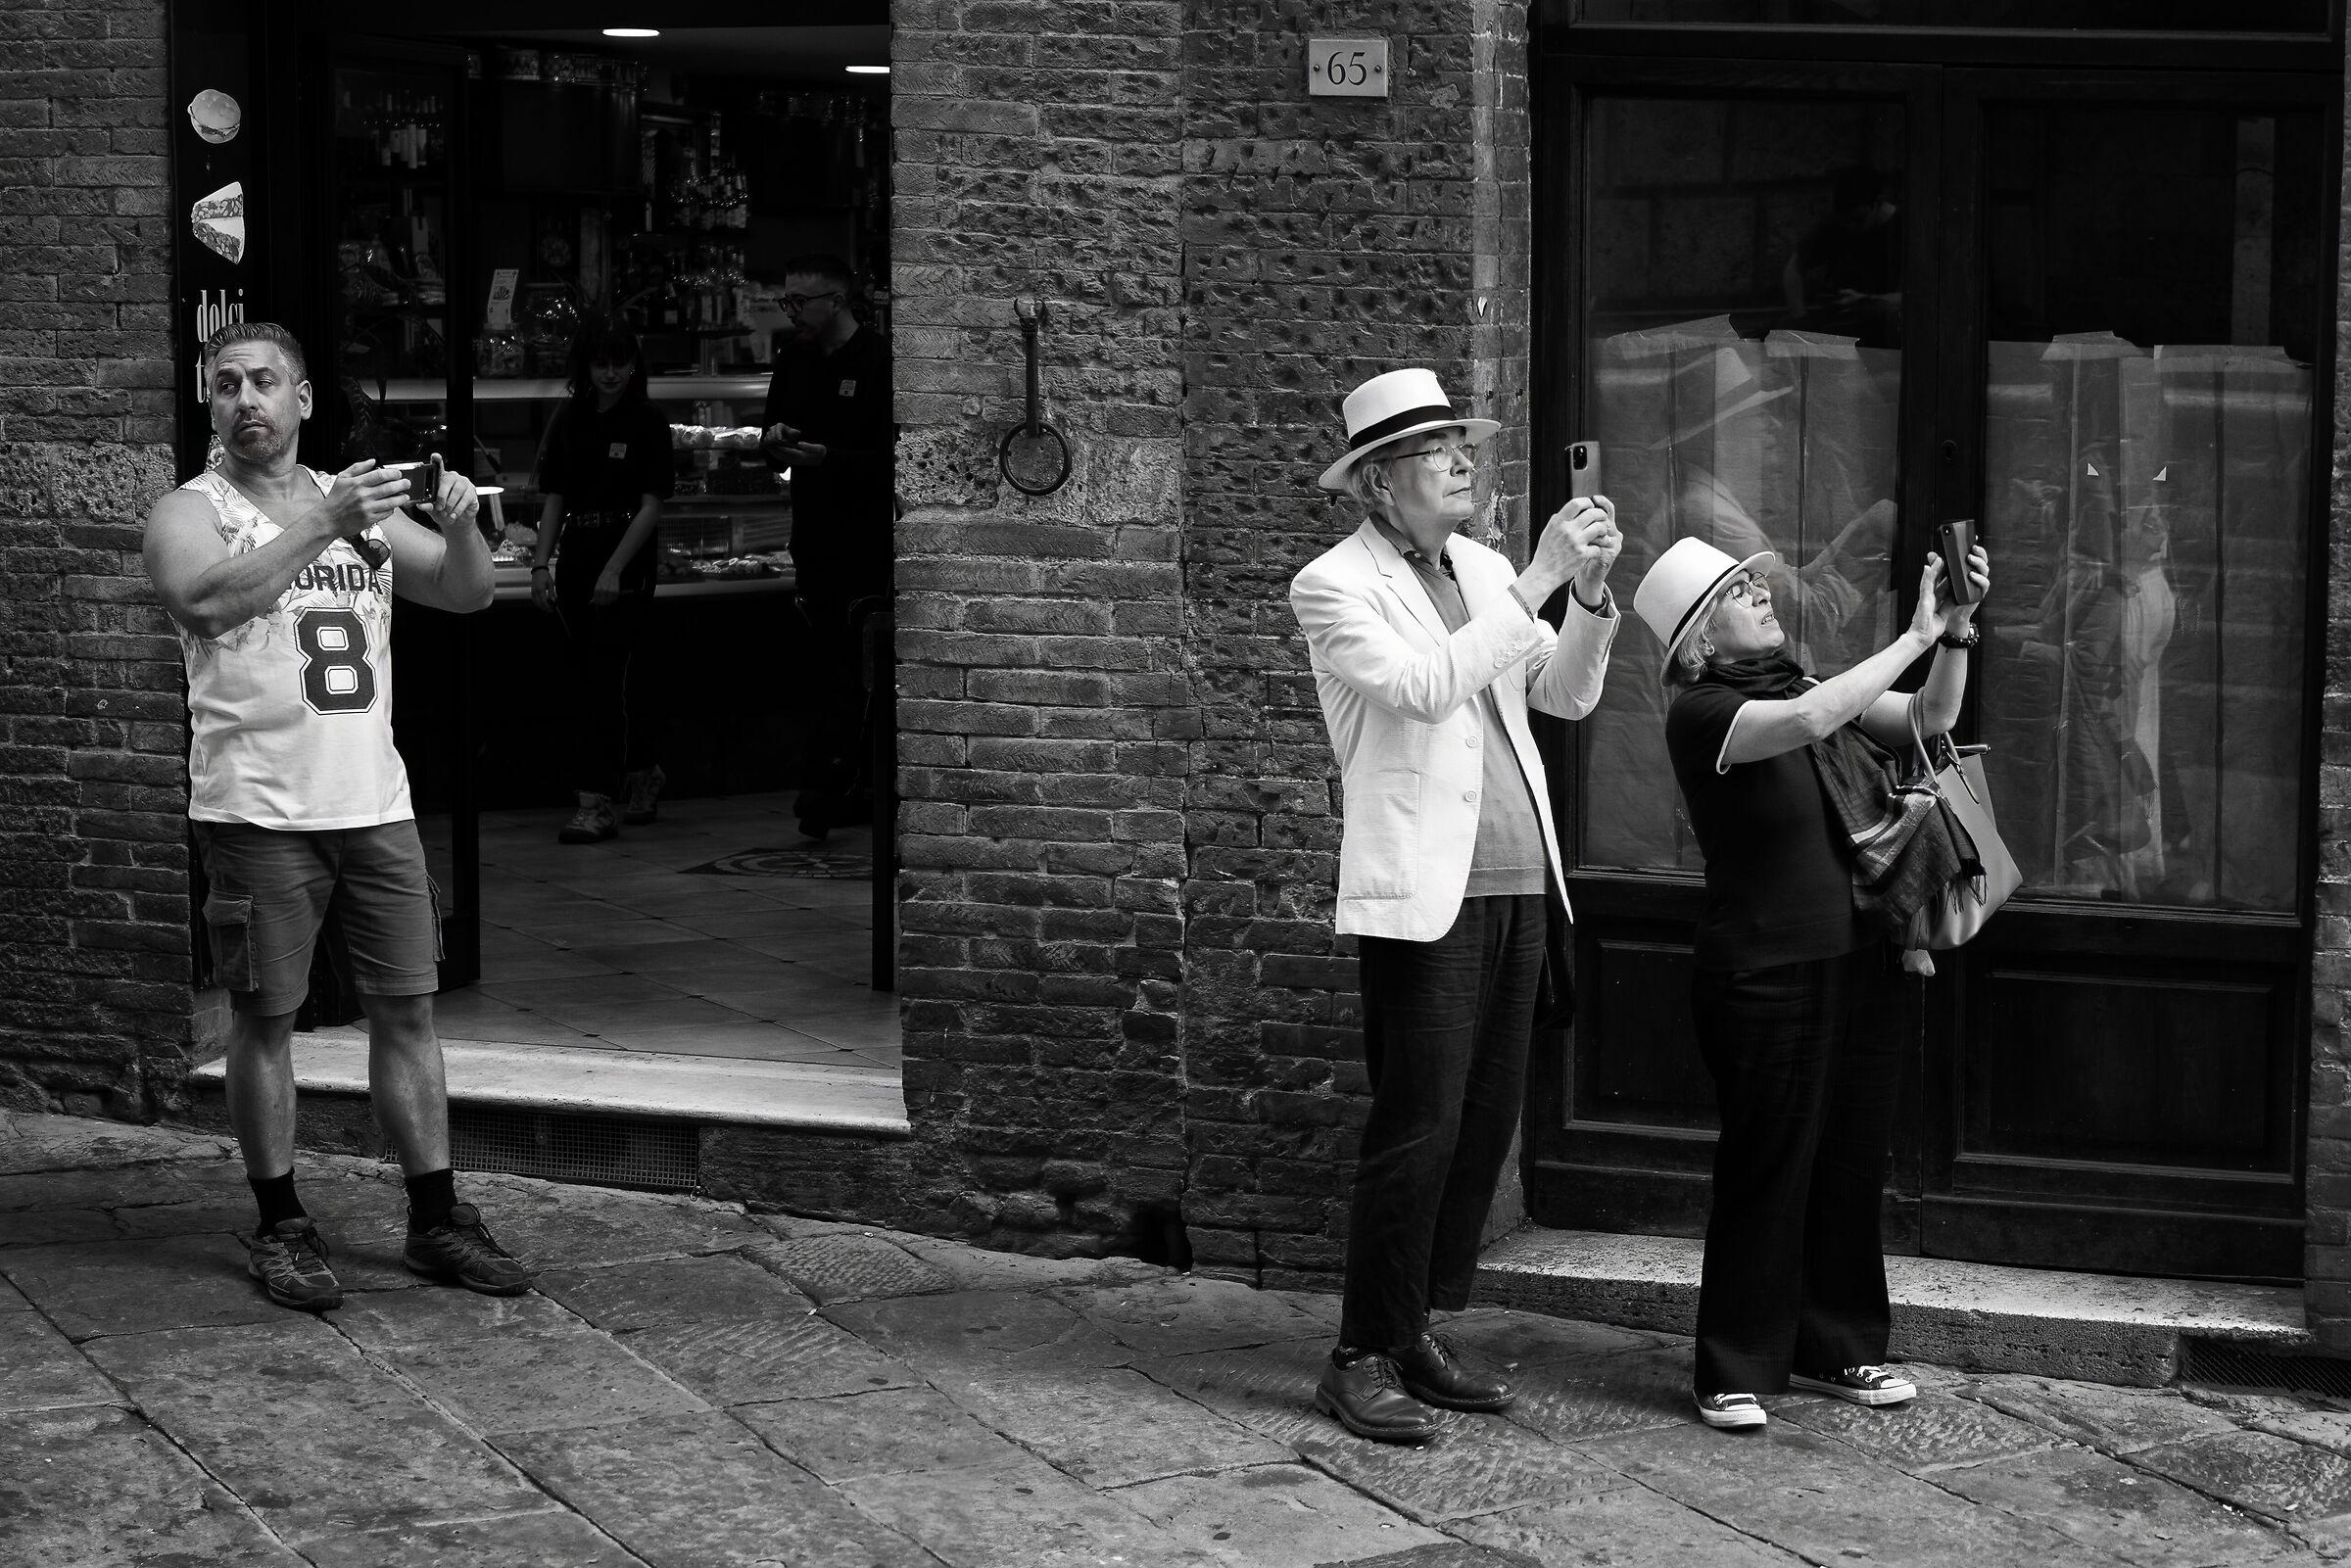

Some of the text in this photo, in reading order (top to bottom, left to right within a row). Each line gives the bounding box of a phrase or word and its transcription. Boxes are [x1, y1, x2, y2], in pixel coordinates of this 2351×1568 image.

[1327, 51, 1367, 86] 65
[294, 563, 383, 594] ORIDA
[293, 606, 379, 716] 8
